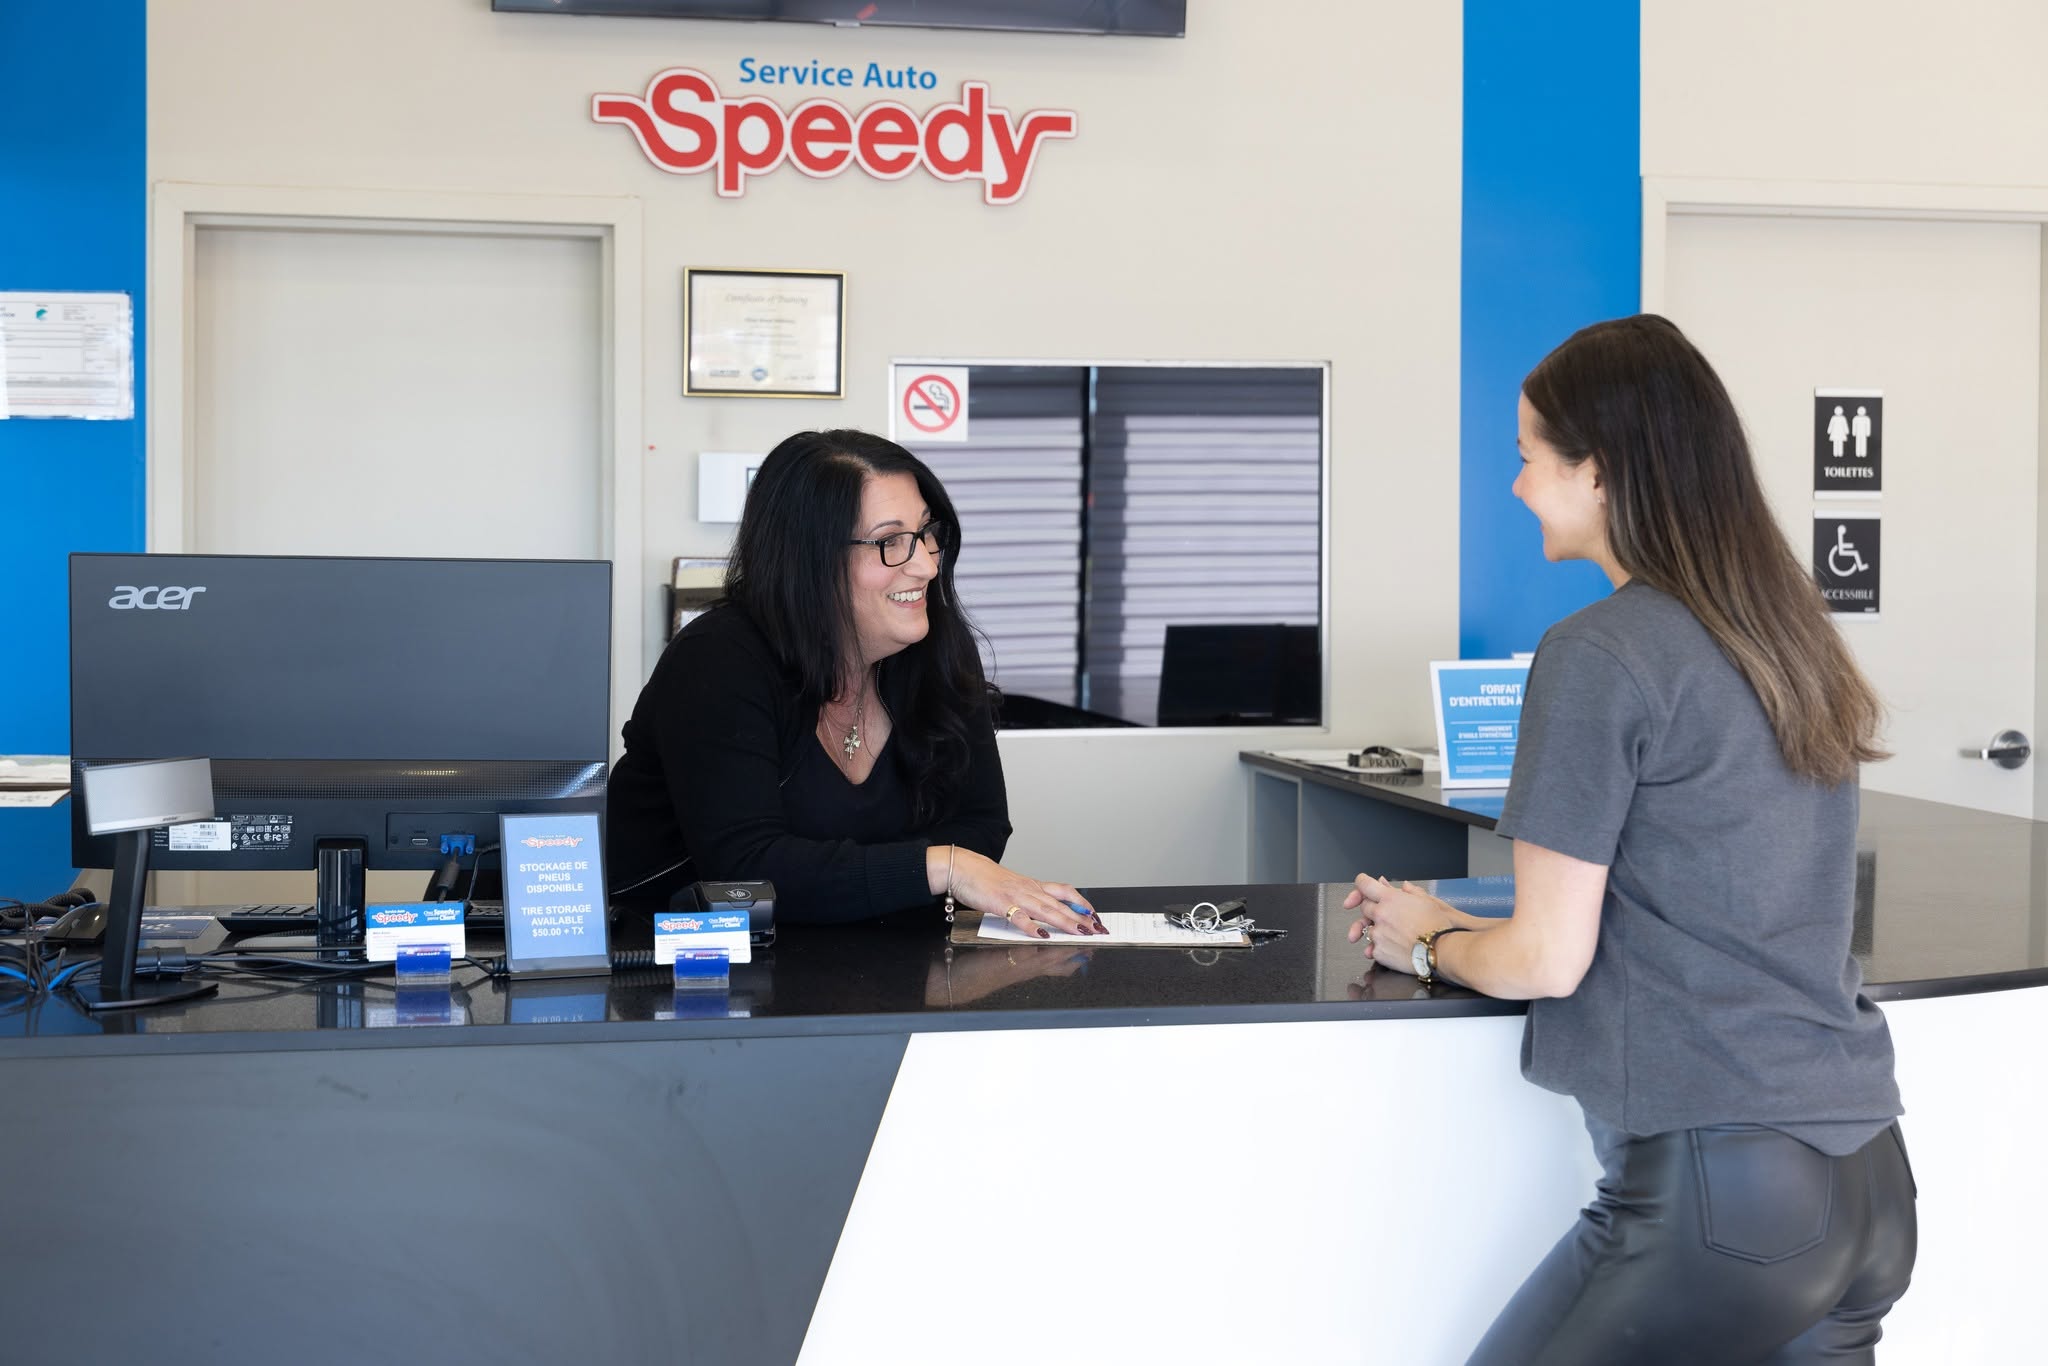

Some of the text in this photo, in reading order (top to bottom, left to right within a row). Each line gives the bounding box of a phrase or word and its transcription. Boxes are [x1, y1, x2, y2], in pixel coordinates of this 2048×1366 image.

[738, 56, 938, 90] Service Auto
[597, 73, 1073, 200] Speedy
[1823, 466, 1874, 478] TOILETTES
[108, 585, 207, 610] acer
[1480, 684, 1522, 695] FORFAIT
[1449, 695, 1514, 707] D'ENTRETIEN
[1369, 758, 1408, 768] PRADA
[520, 836, 583, 848] Speedy
[519, 861, 589, 872] STOCKAGE DE
[538, 873, 571, 882] PNEUS
[526, 883, 584, 894] DISPONIBLE
[520, 904, 592, 916] TIRE STORAGE
[372, 911, 418, 925] Speedy
[531, 915, 584, 926] AVAILABLE
[532, 927, 561, 937] $50.00
[571, 926, 584, 935] TX
[658, 919, 703, 932] Speedy
